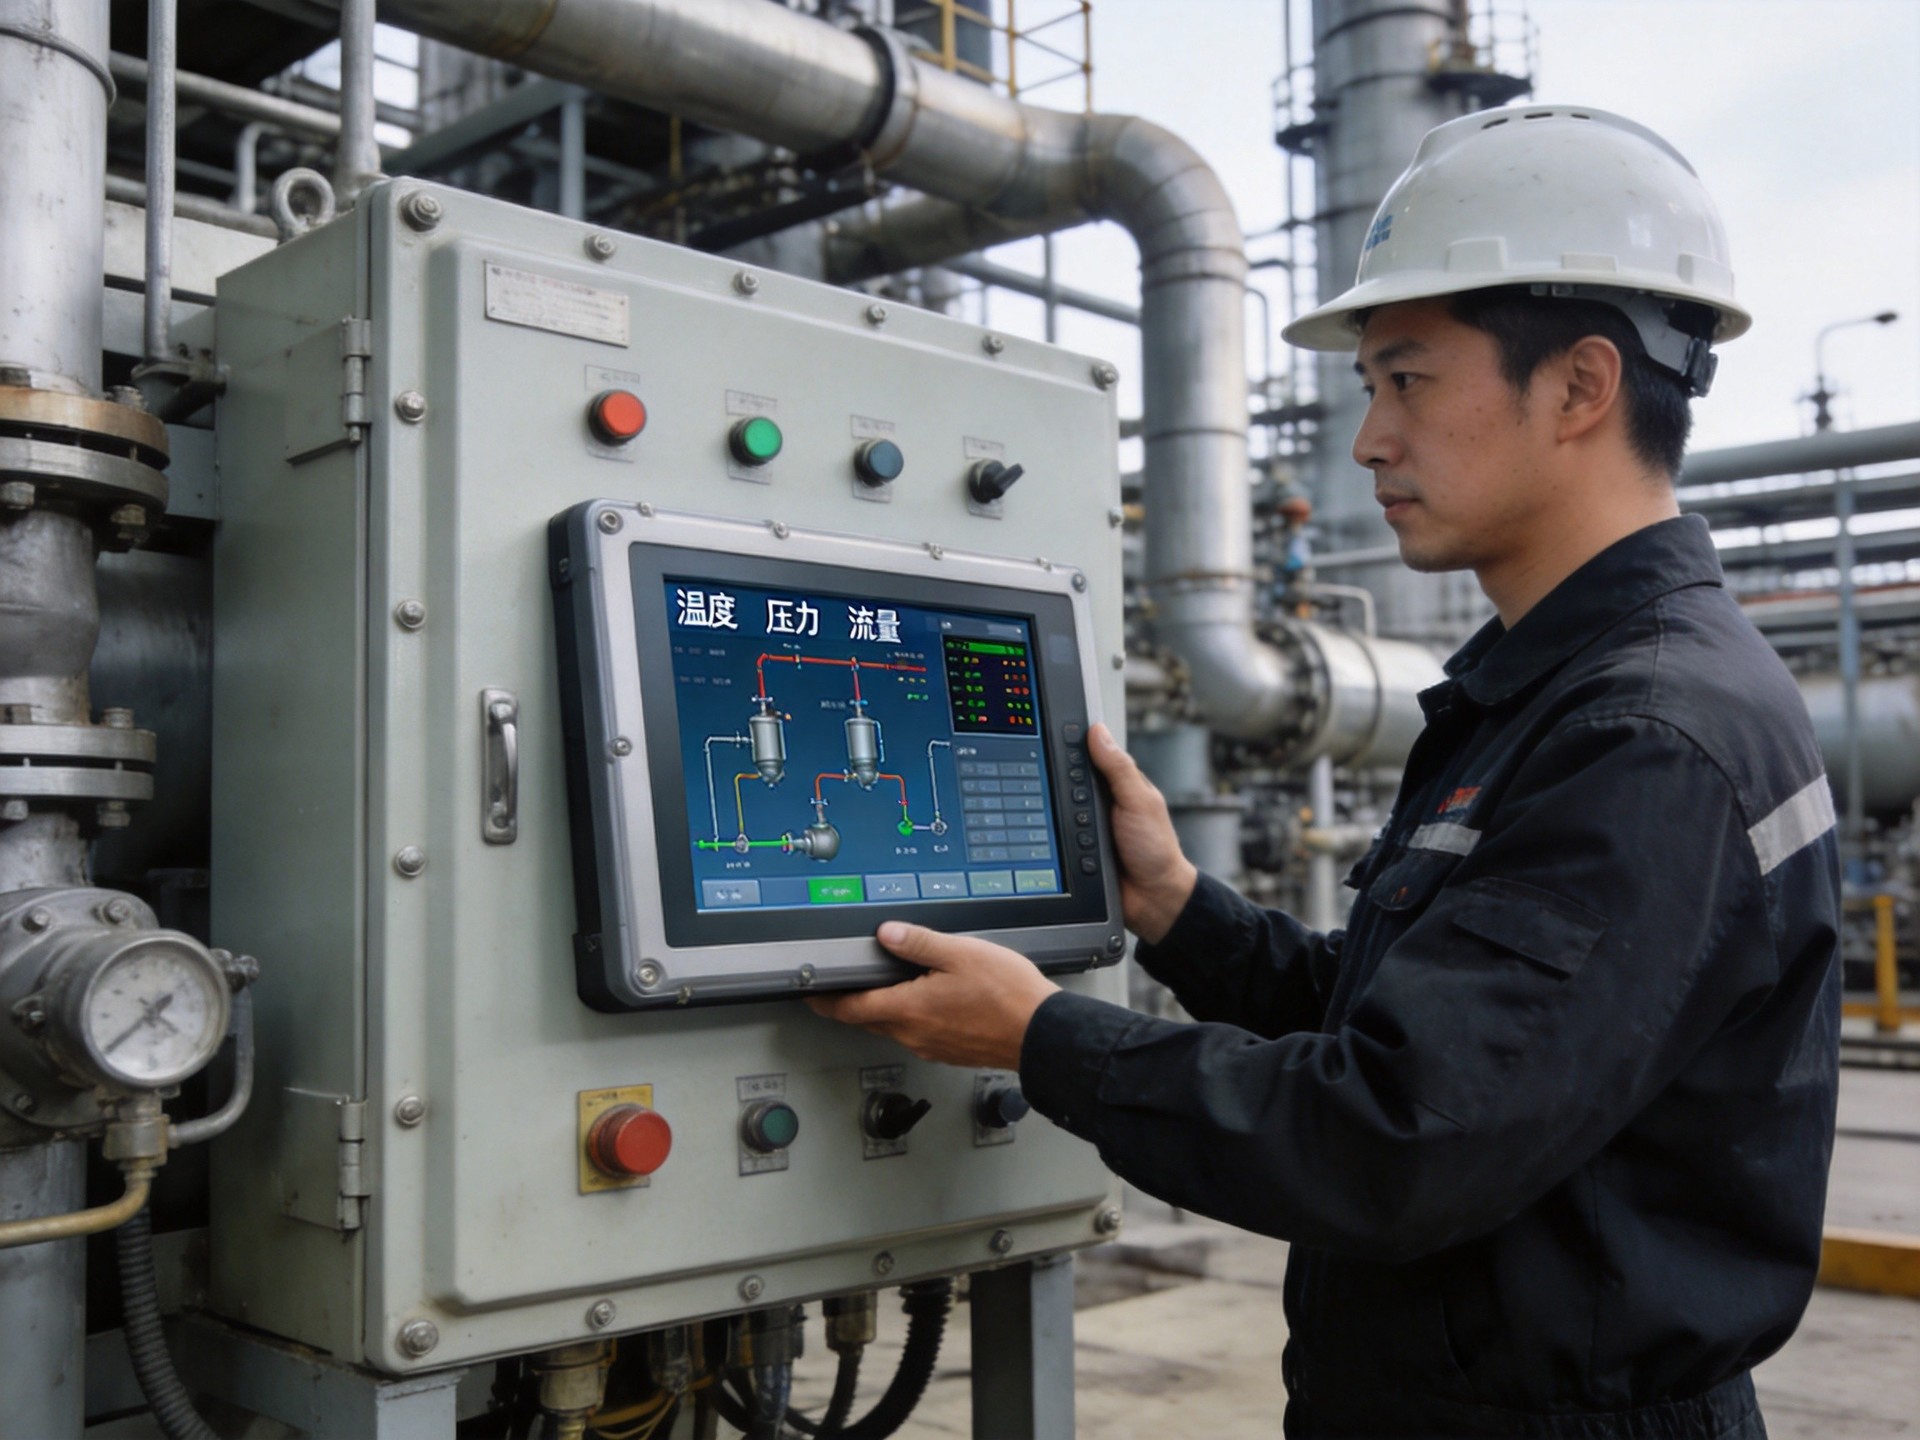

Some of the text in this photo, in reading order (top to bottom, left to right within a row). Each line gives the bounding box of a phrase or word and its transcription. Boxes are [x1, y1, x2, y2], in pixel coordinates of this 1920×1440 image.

[676, 588, 738, 630] 温度
[766, 599, 819, 636] 压力
[848, 605, 902, 644] 流量
